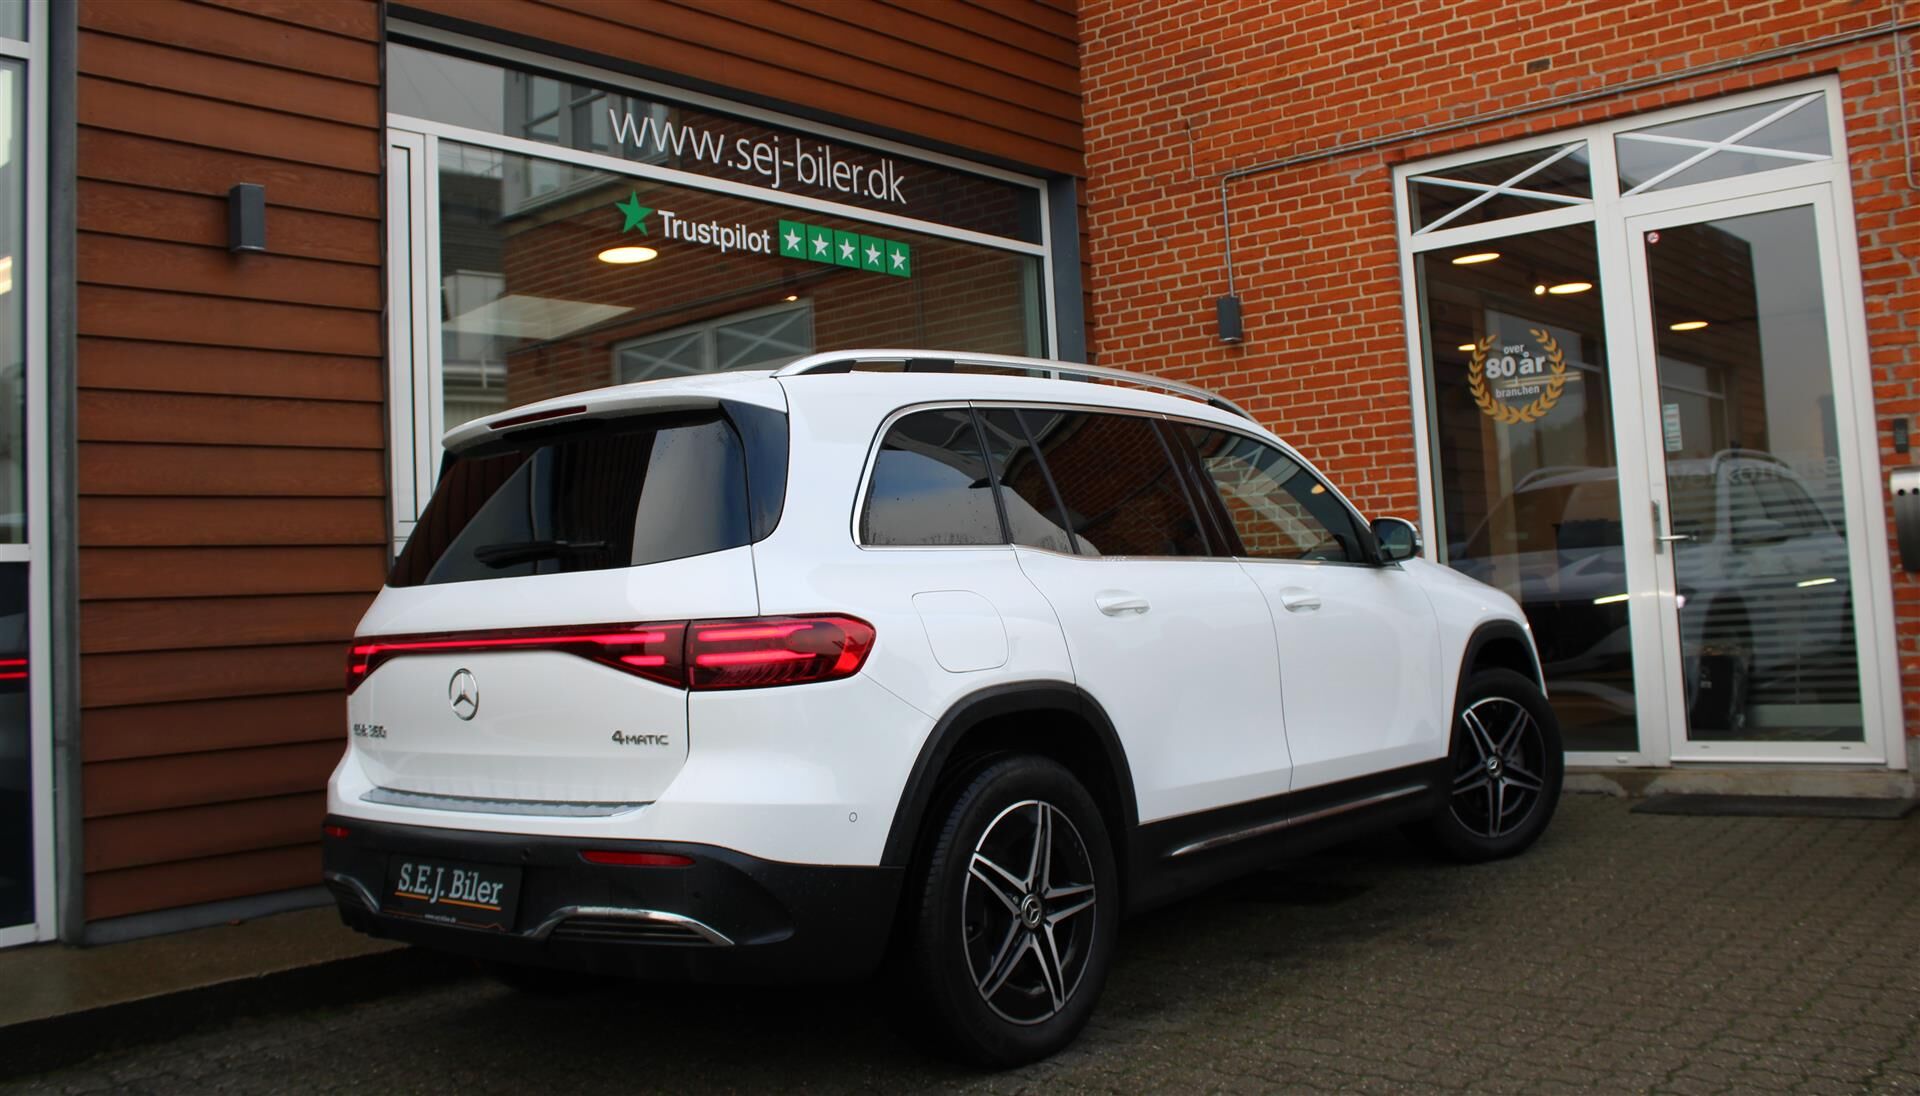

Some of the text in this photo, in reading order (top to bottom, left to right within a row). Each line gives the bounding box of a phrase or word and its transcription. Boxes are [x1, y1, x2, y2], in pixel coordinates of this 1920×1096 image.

[609, 108, 907, 204] www.sej-biler.dk
[657, 209, 772, 254] Trustpilot
[1503, 344, 1525, 355] over
[1485, 351, 1546, 379] 80 år
[1495, 385, 1541, 399] branchen
[611, 730, 669, 745] 4MATIC
[398, 862, 503, 905] S.E.J. Biler
